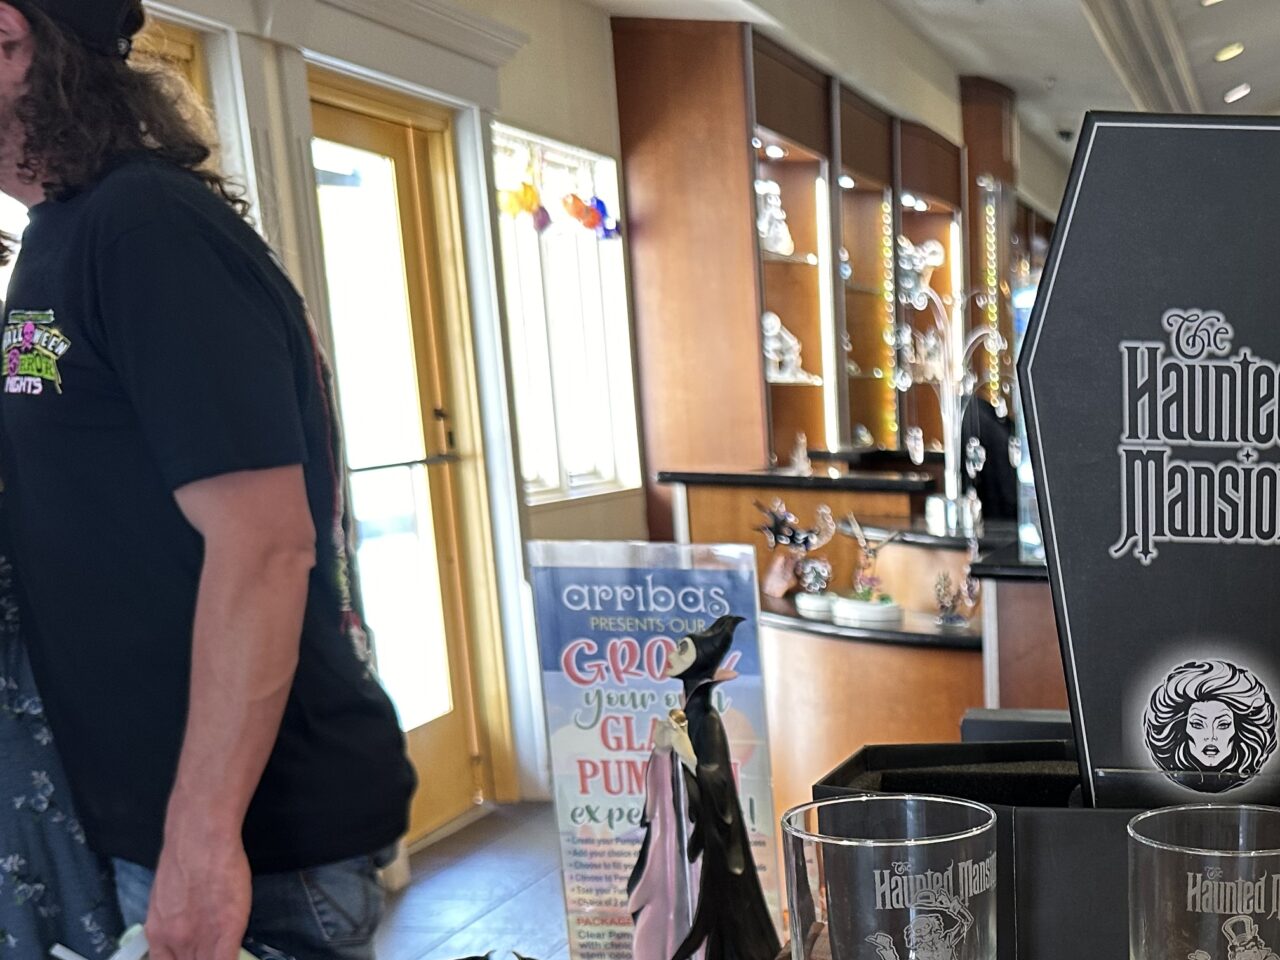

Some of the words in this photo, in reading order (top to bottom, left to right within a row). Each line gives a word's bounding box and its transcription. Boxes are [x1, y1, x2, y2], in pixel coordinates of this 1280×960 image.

[1161, 308, 1235, 361] The
[562, 574, 730, 619] arribas
[590, 616, 664, 633] PRESENTS
[669, 617, 706, 633] OUR
[574, 687, 656, 730] your
[873, 859, 954, 910] Haunted
[1186, 870, 1267, 915] Haunted
